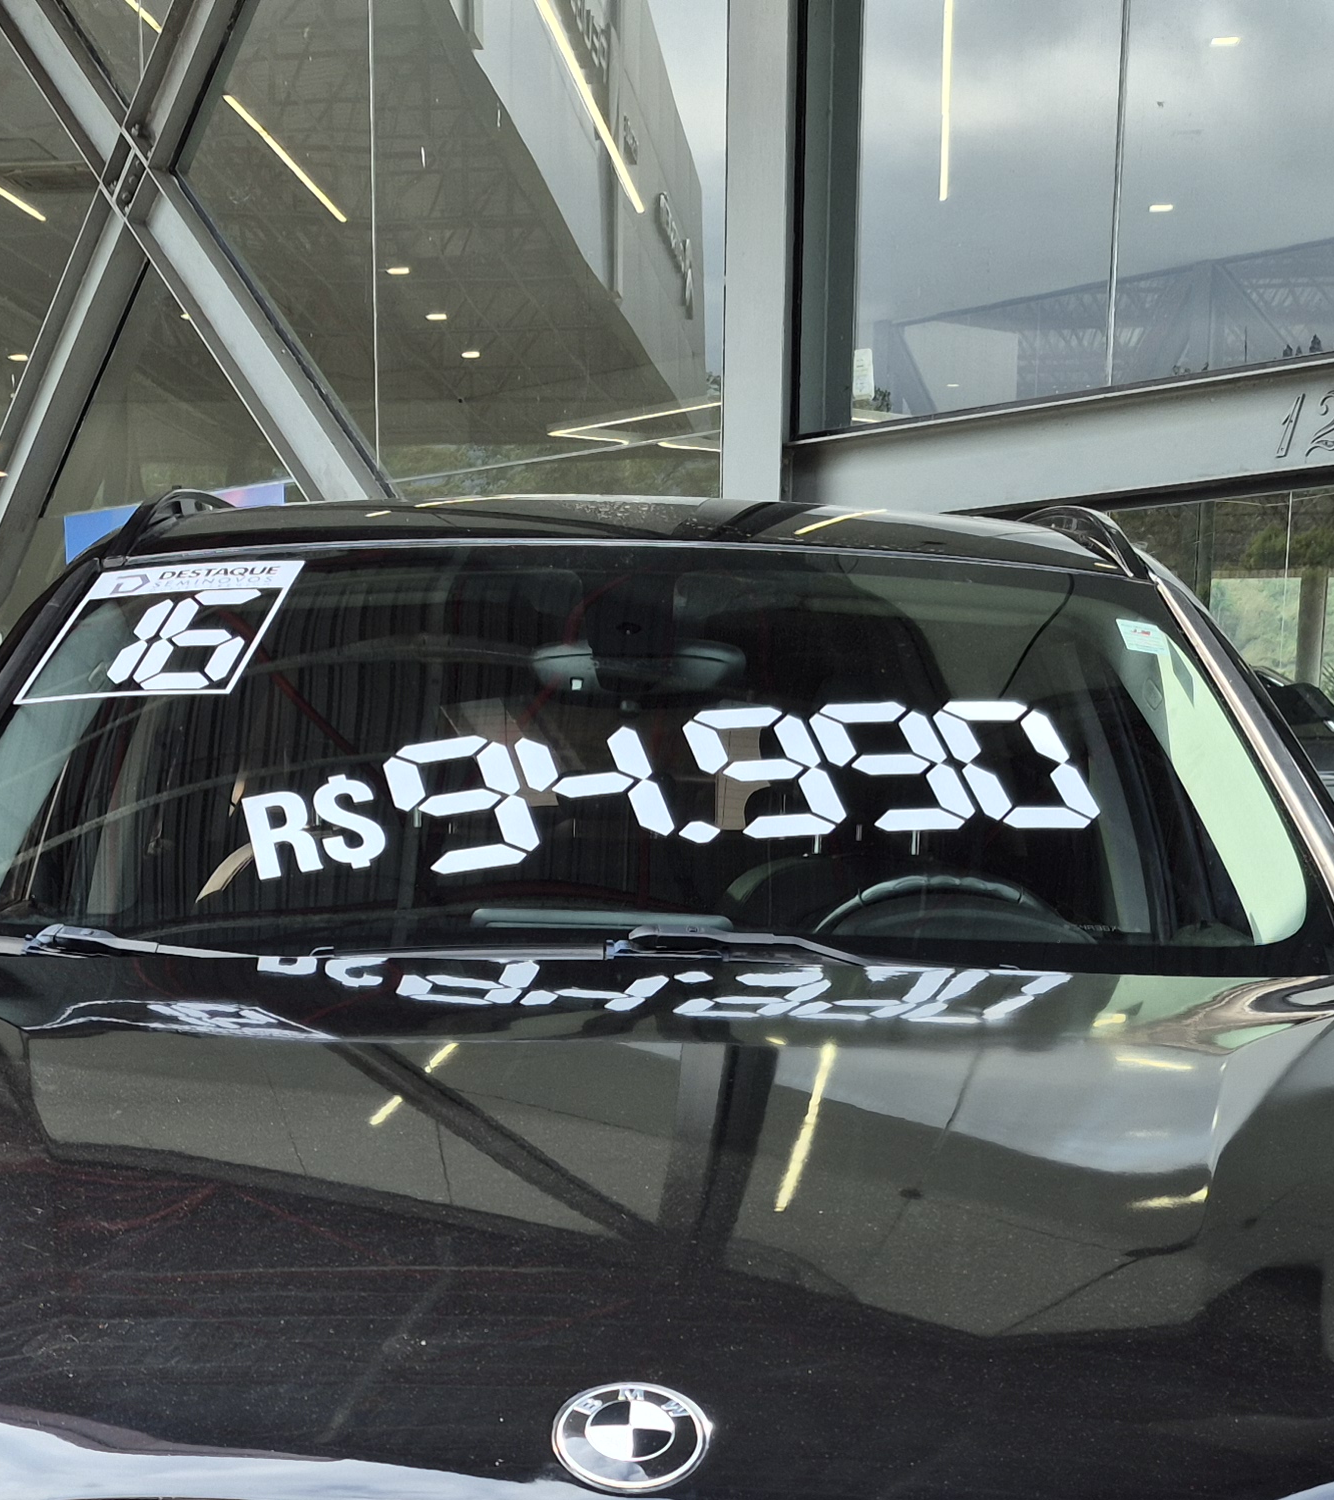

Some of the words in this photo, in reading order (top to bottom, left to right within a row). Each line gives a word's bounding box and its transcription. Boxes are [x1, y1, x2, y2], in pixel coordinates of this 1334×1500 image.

[153, 575, 275, 588] SEMINOVOS
[159, 566, 280, 580] DESTAQUE
[107, 588, 246, 691] 16
[241, 774, 387, 881] R$
[382, 700, 1102, 875] 94.990
[573, 1388, 691, 1418] BMW
